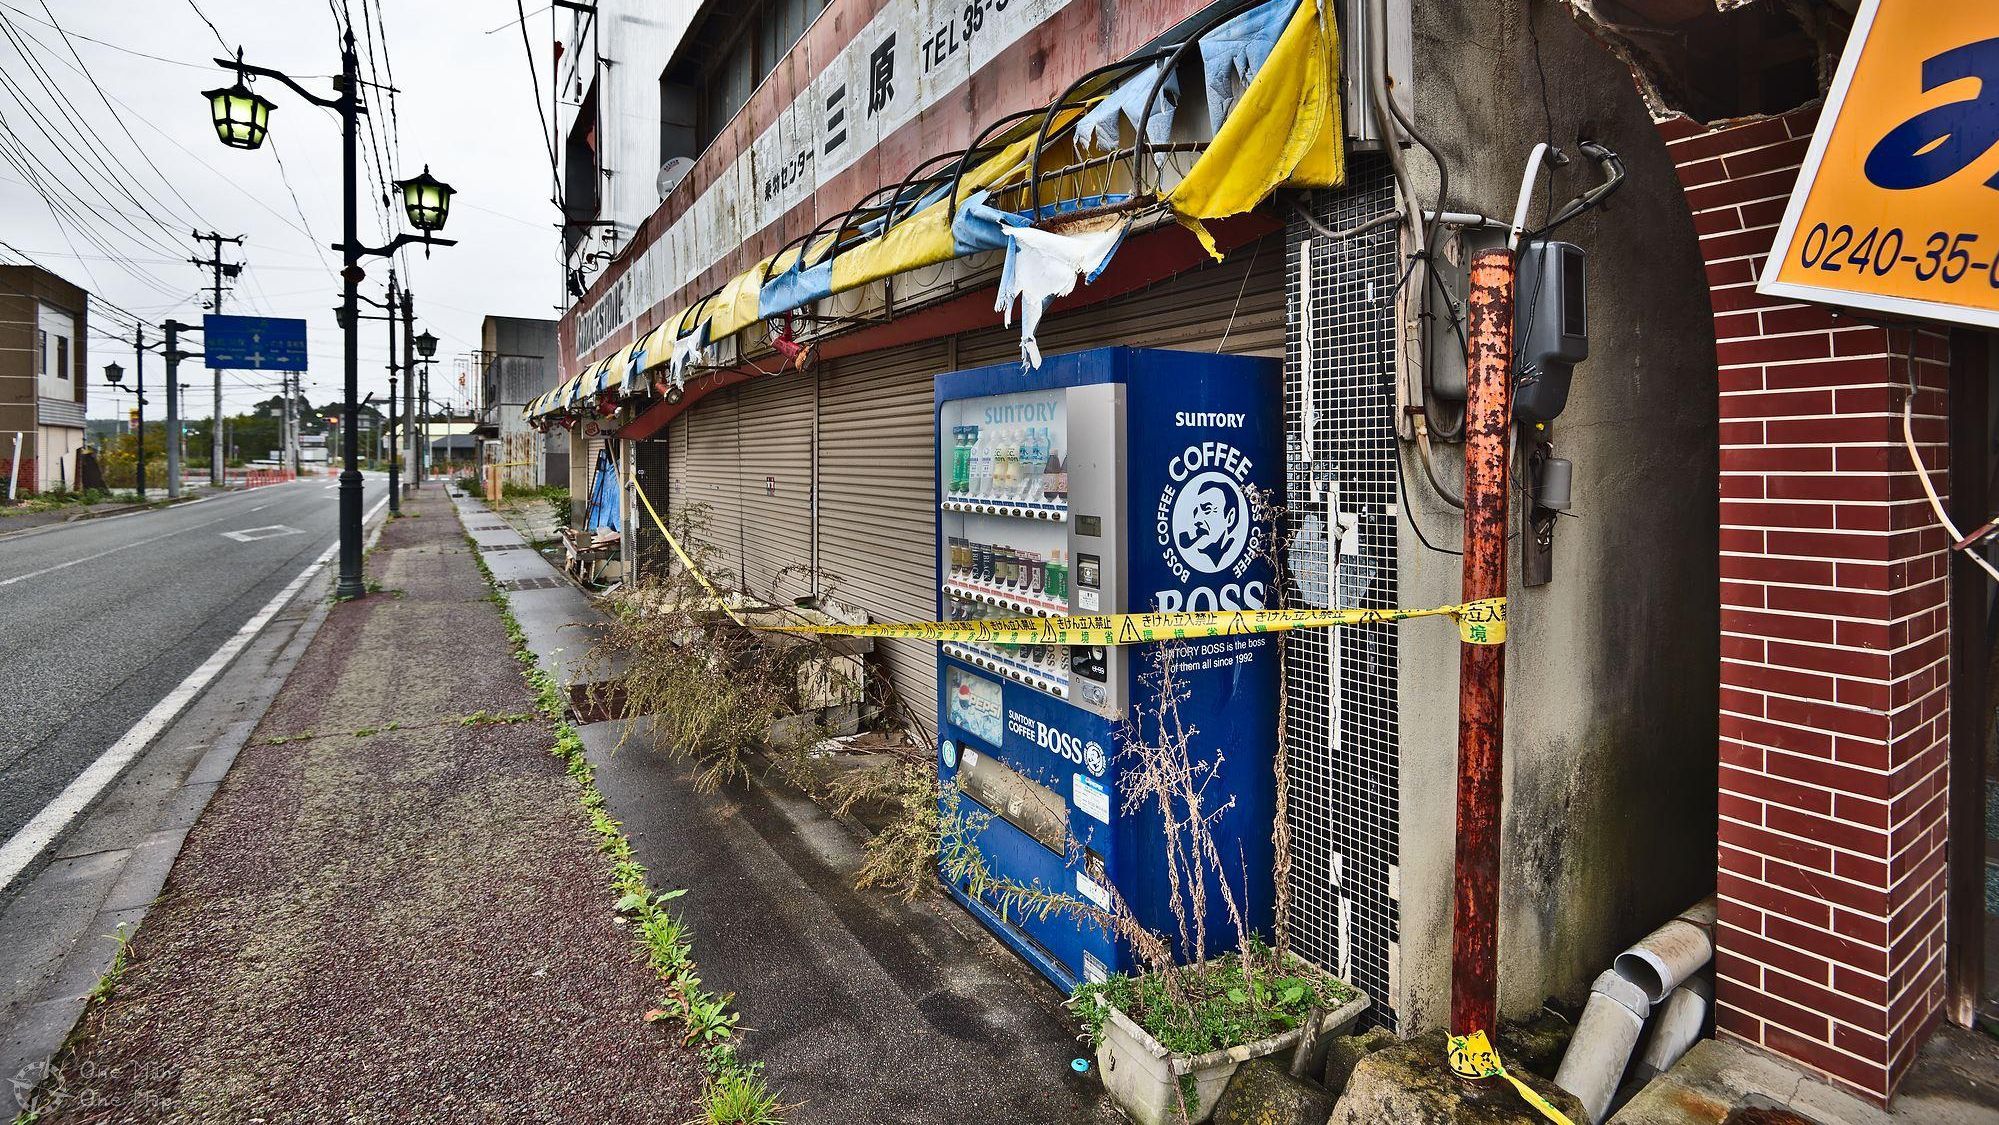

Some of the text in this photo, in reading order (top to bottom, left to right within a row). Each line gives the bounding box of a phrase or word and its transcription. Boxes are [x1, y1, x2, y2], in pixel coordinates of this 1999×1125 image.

[922, 18, 959, 74] TEL
[765, 31, 896, 202] 乗物センター 三原
[1801, 222, 1999, 289] 0240-35-
[1168, 441, 1253, 483] COFFEE
[1157, 484, 1191, 584] BOSS COFFEE
[1232, 526, 1262, 579] COFFEE
[1056, 617, 1112, 631] きけん立入禁止
[1142, 612, 1218, 628] きけん立入禁止
[1470, 625, 1487, 642] 境
[1170, 652, 1253, 674] of them all since 1992
[1201, 642, 1226, 656] BOSS
[1226, 641, 1234, 652] is
[1234, 640, 1247, 651] the
[1248, 637, 1266, 648] boss
[969, 693, 1000, 720] PEPSI
[1008, 709, 1037, 727] SUNTORY
[1008, 720, 1036, 743] COFFEE
[1037, 720, 1083, 765] BOSS
